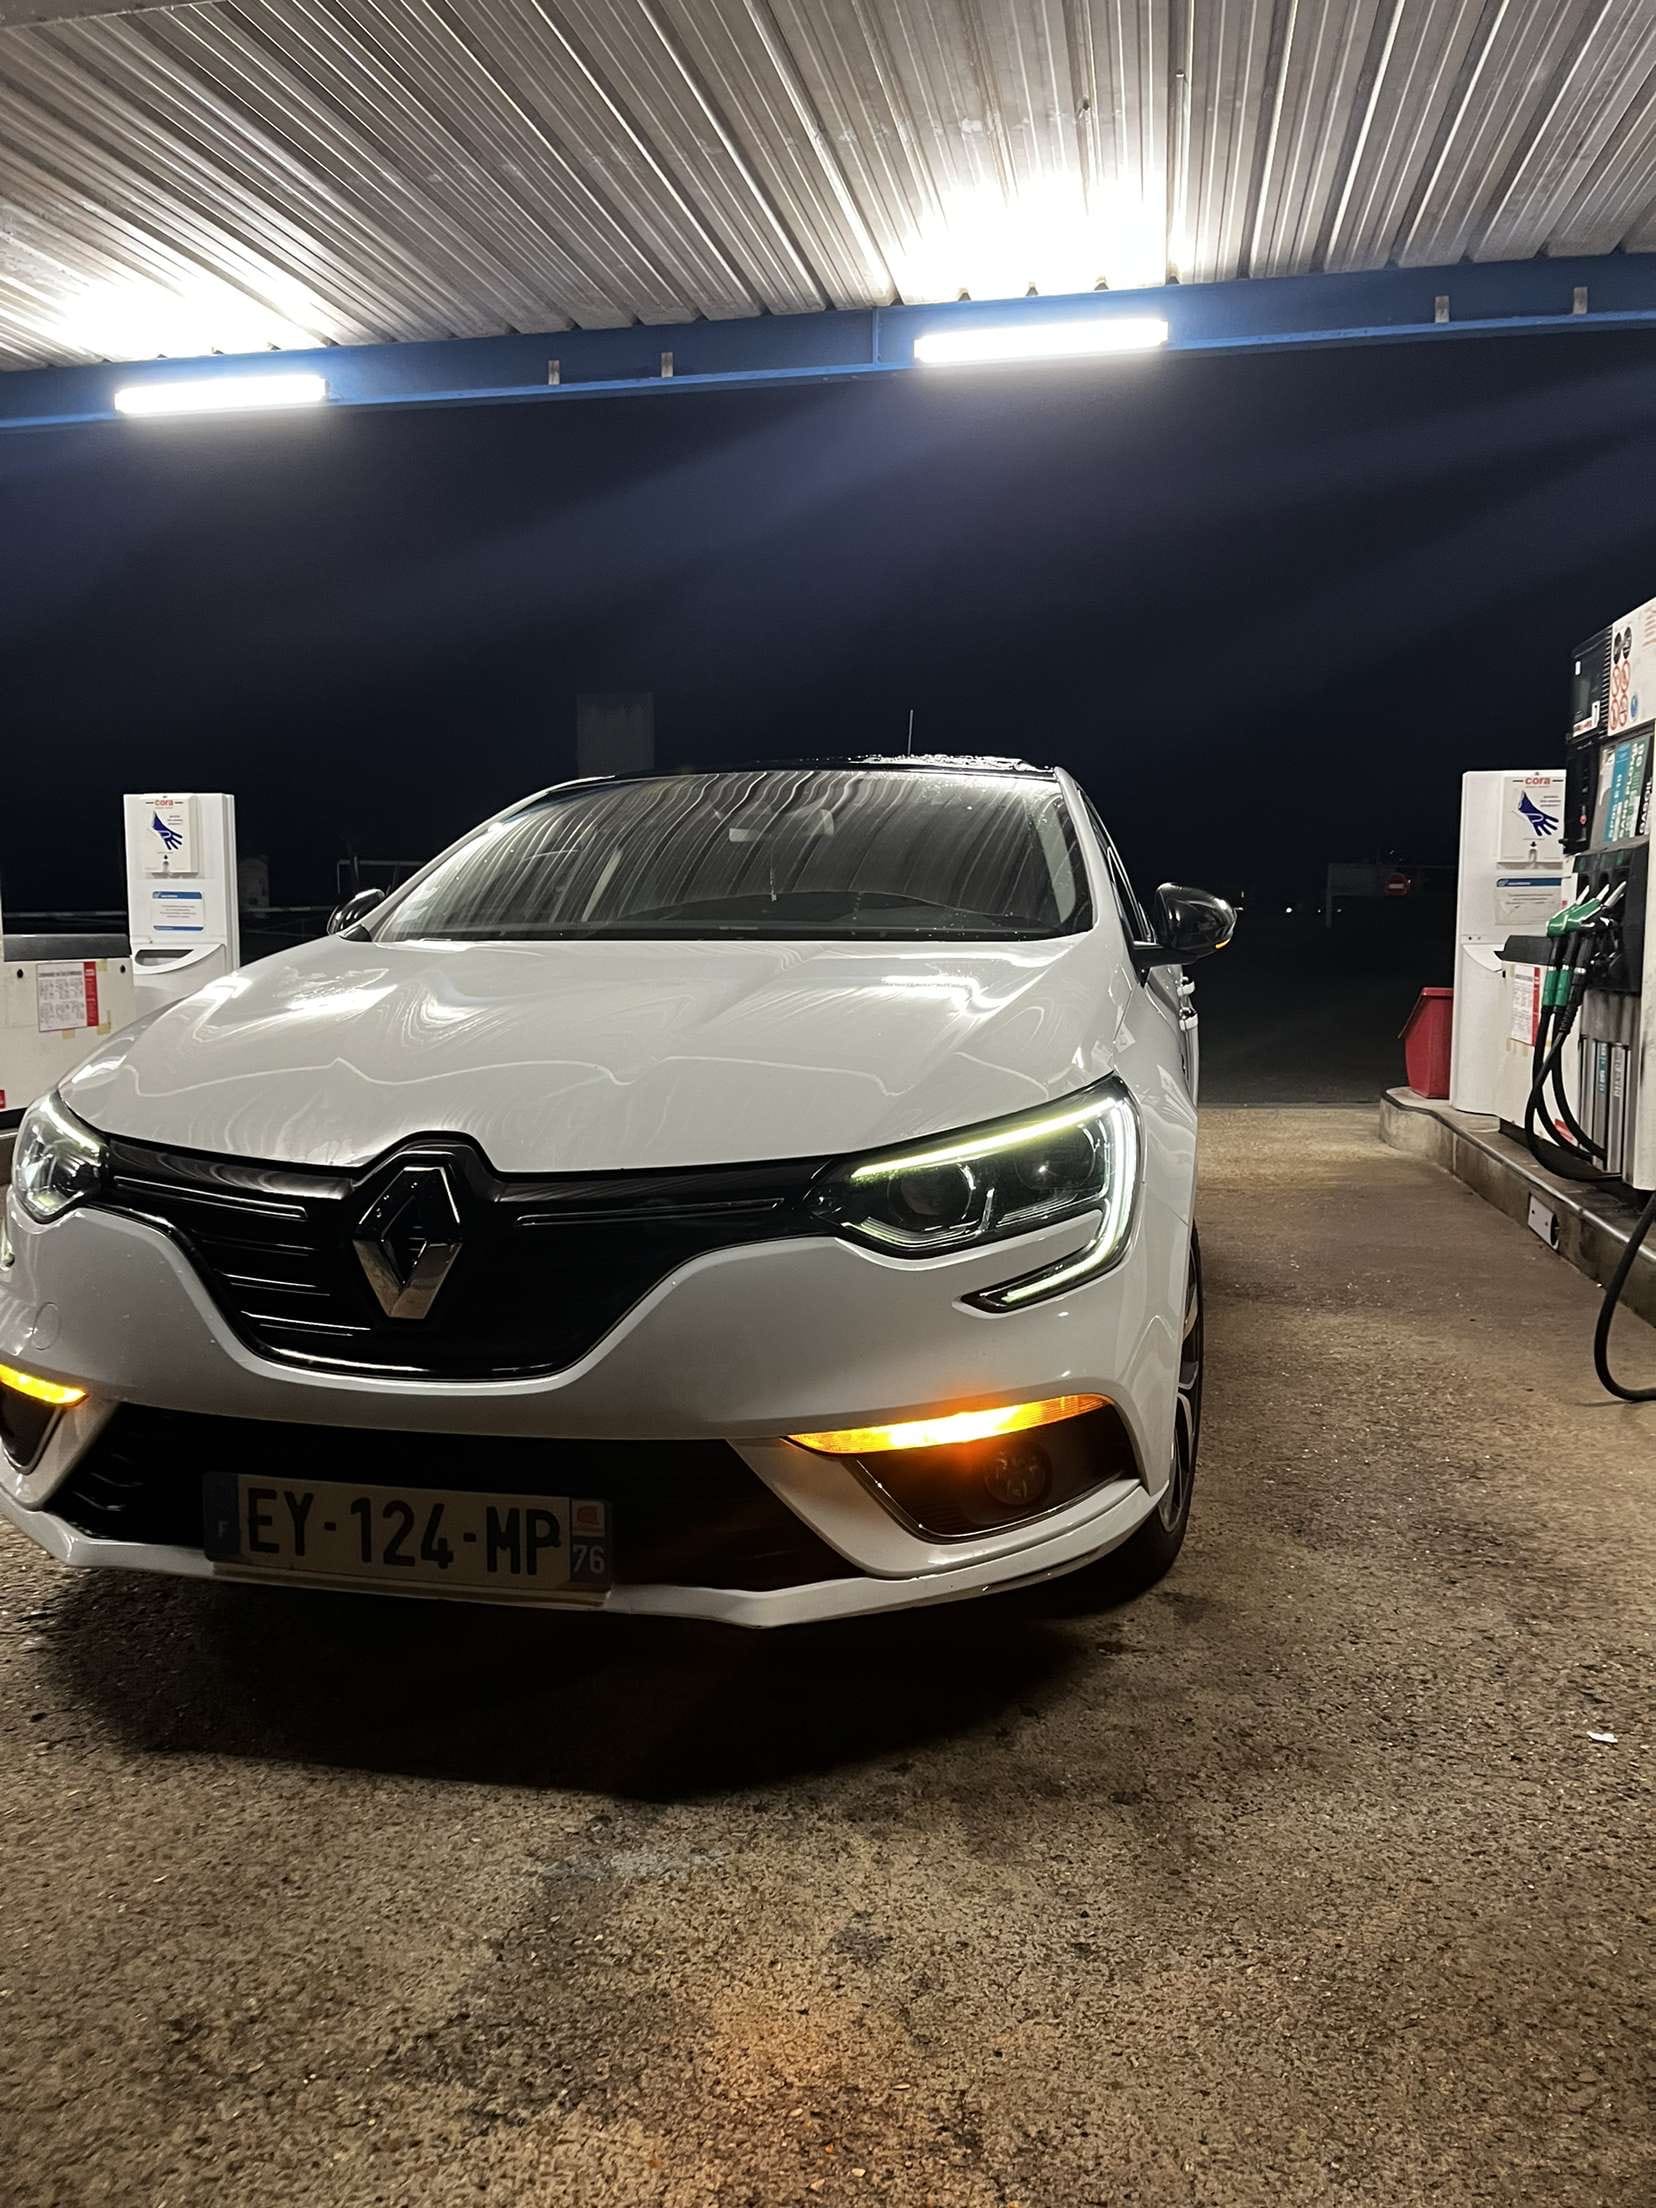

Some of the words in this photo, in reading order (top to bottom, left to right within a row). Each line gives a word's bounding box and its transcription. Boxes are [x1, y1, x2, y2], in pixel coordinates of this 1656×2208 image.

[1525, 777, 1550, 785] cora
[217, 1520, 228, 1539] F
[248, 1486, 561, 1576] EY-124-MP
[572, 1543, 606, 1575] 76
